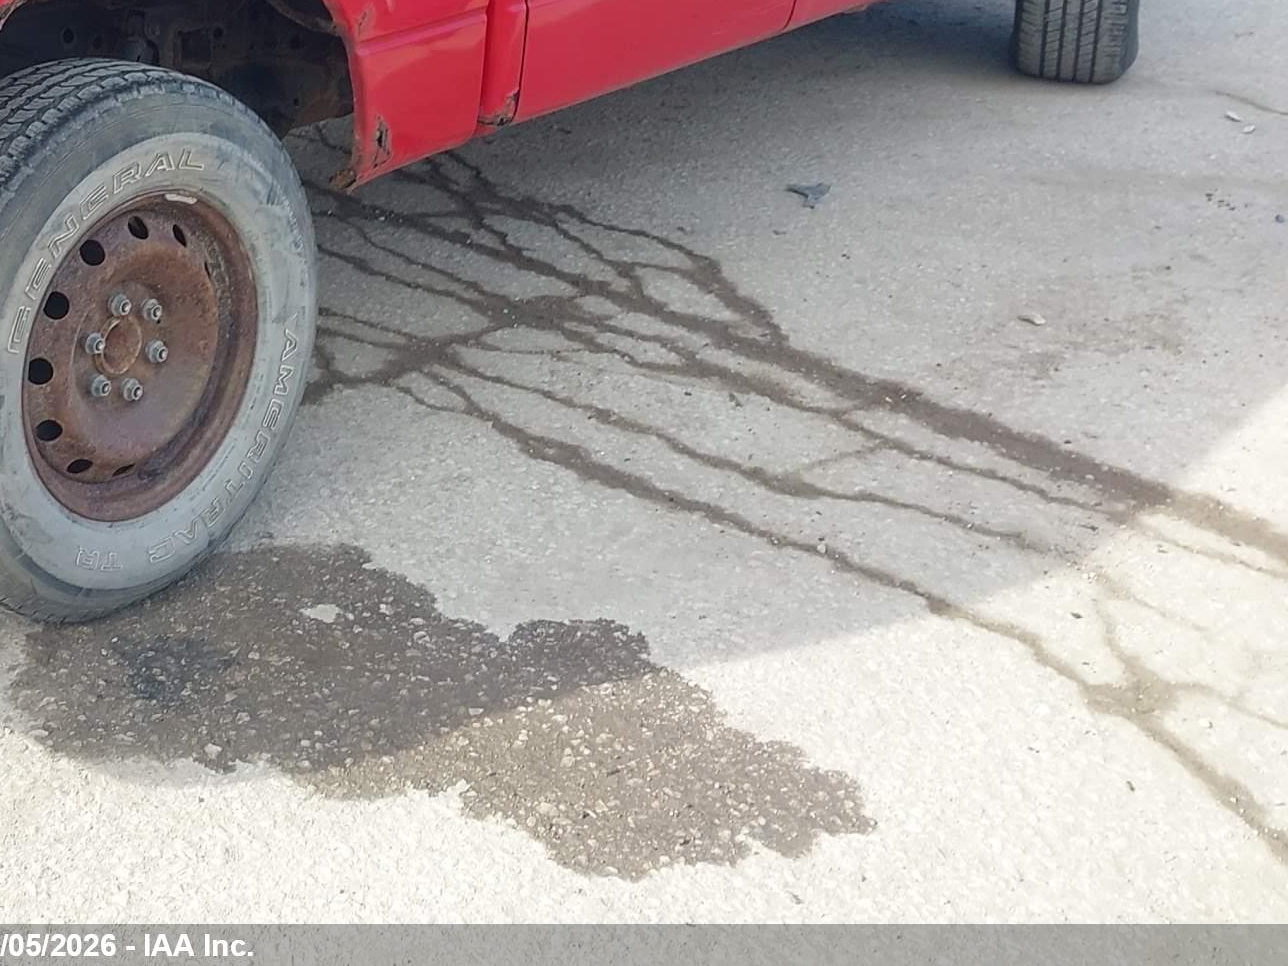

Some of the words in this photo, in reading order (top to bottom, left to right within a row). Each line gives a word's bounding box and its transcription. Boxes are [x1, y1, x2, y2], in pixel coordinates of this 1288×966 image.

[7, 148, 204, 353] GENERAL
[148, 329, 299, 562] AMERITRAC
[76, 546, 123, 572] TR
